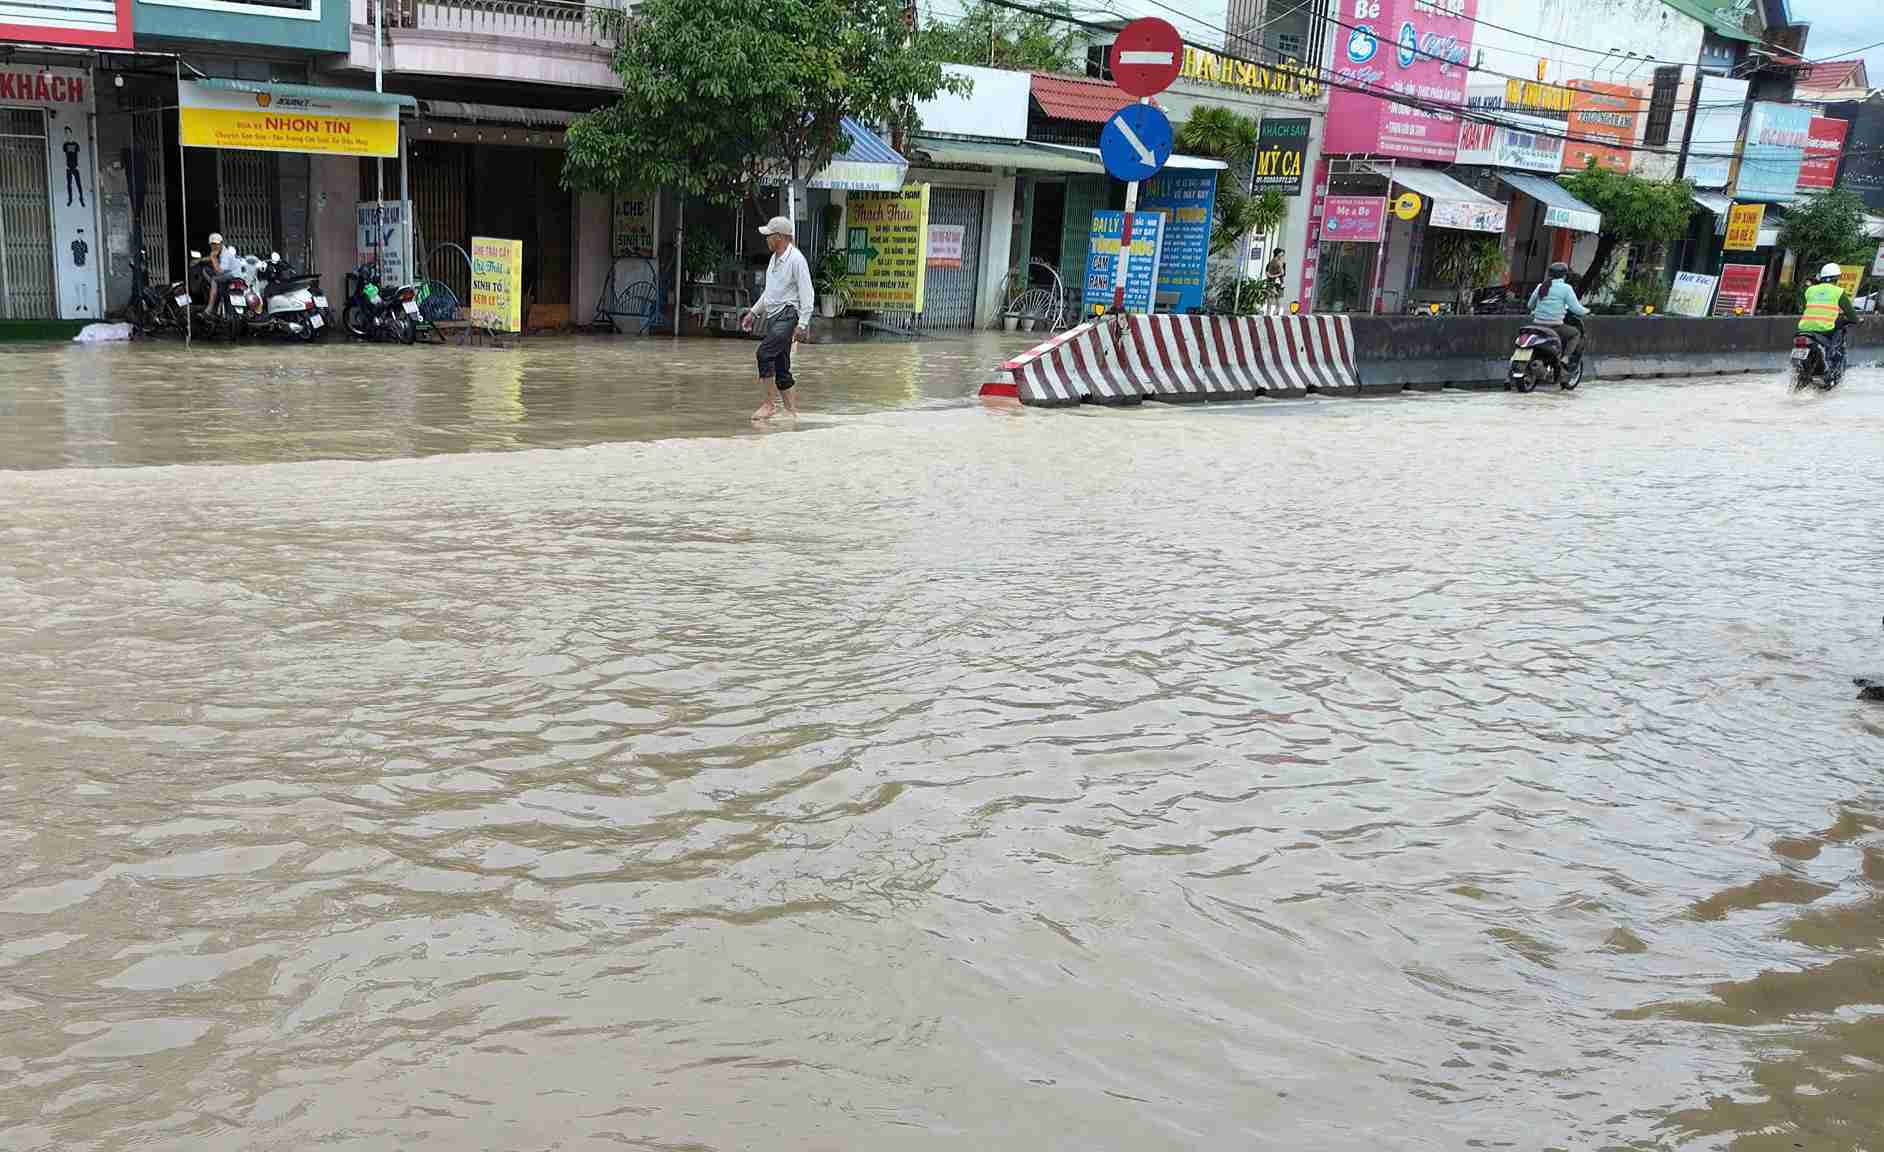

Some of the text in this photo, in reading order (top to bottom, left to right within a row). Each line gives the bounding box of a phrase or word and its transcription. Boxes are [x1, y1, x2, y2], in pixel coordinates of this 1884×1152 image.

[0, 69, 83, 104] KHÁCH
[1282, 151, 1301, 176] CA
[473, 280, 491, 291] SINH
